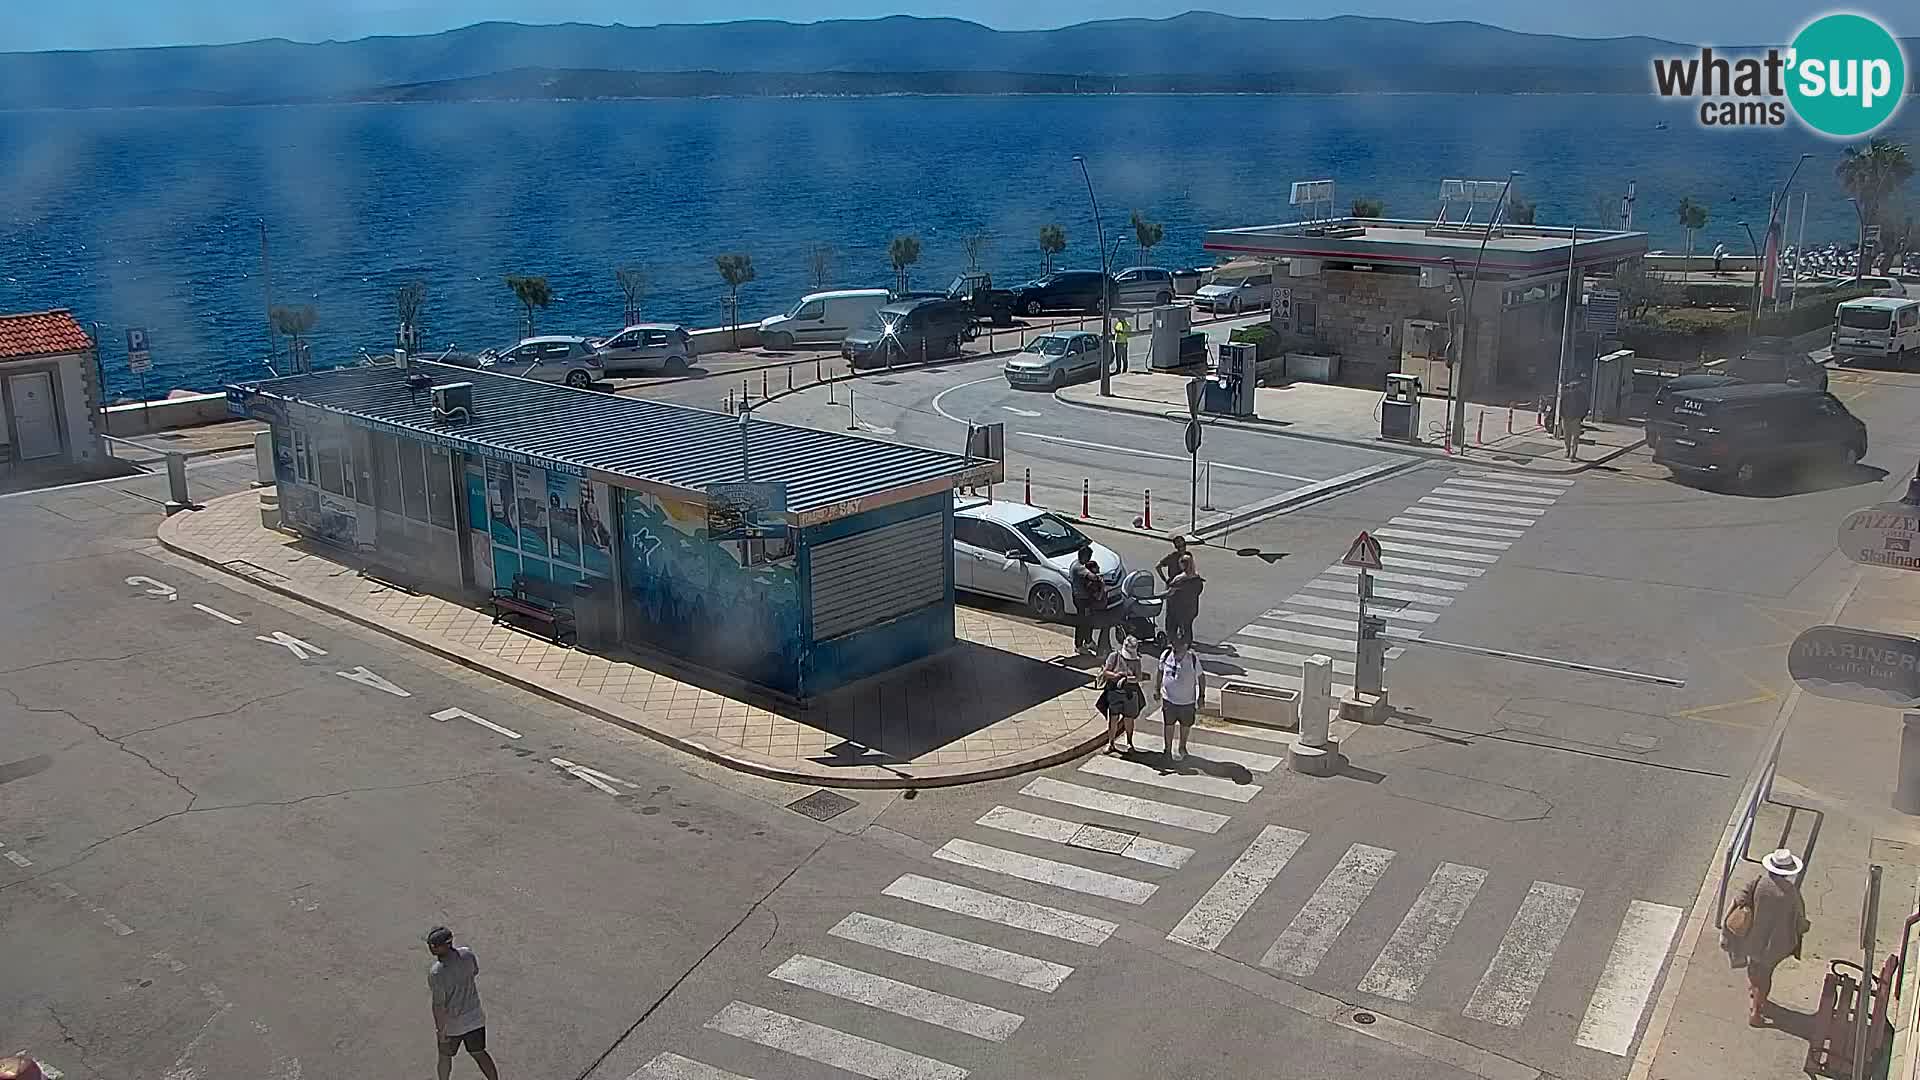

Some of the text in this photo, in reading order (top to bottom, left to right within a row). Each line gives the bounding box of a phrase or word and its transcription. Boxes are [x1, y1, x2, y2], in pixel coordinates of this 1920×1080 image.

[1684, 400, 1702, 410] TAXI
[438, 437, 468, 451] POSTAJA
[479, 446, 494, 457] BUS
[495, 449, 527, 464] STATION
[529, 456, 555, 470] TICKET
[557, 462, 583, 476] OFFICE
[1849, 514, 1920, 532] PIZZE
[1801, 642, 1920, 671] MARINER
